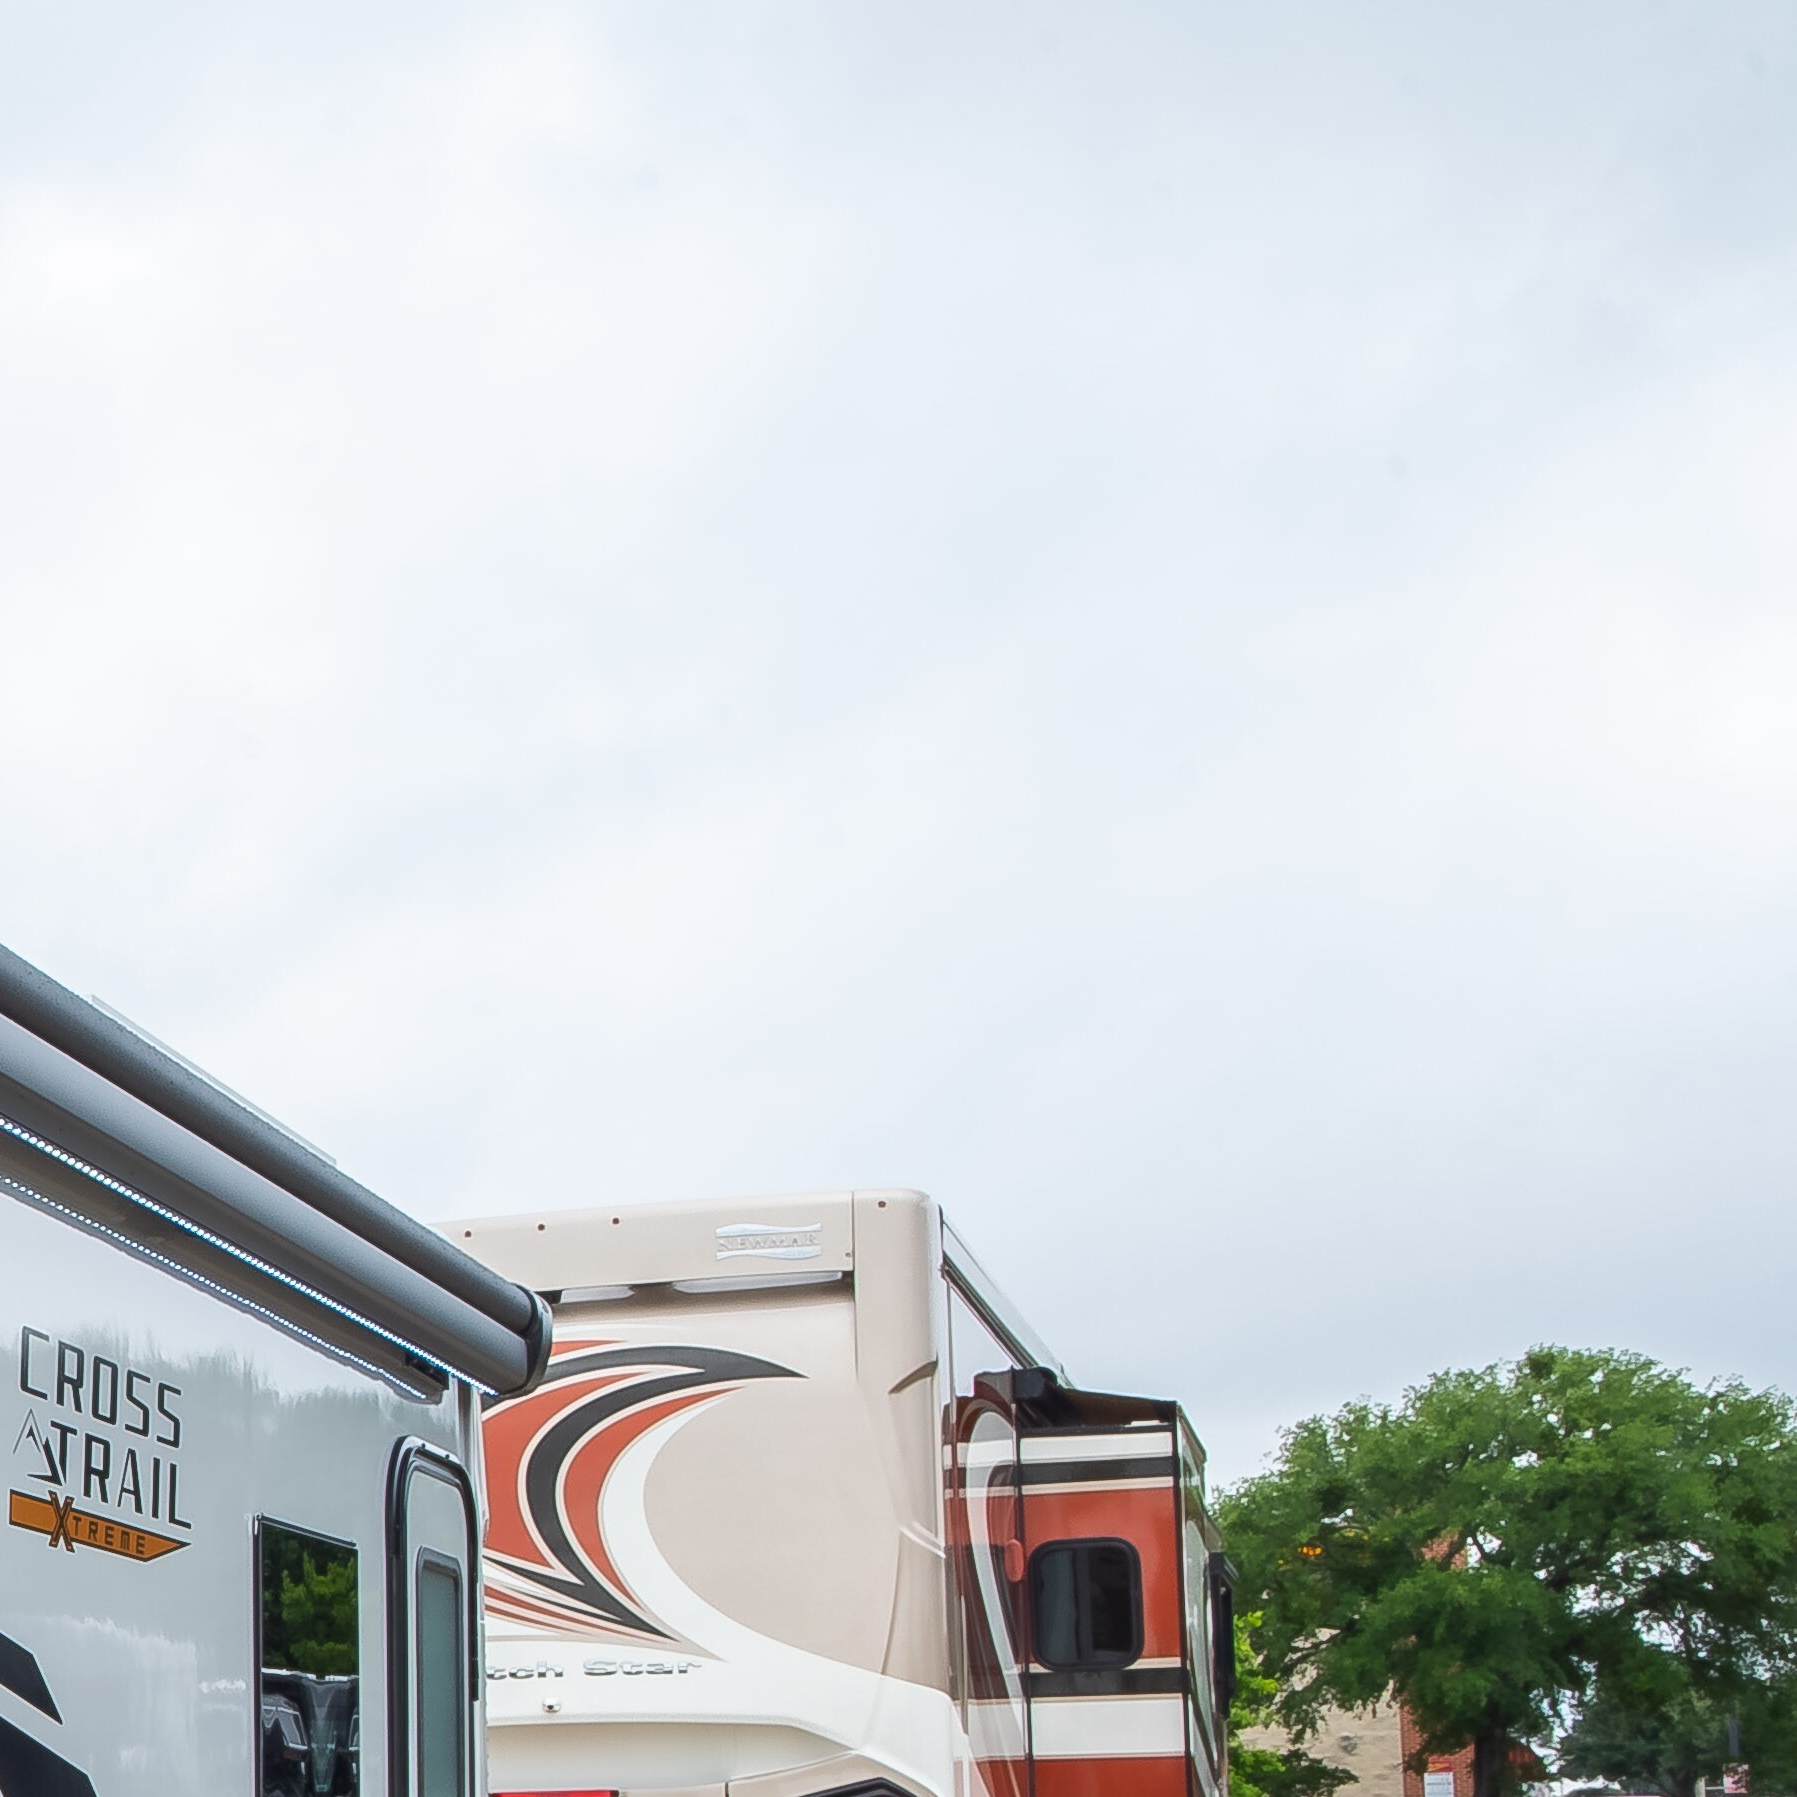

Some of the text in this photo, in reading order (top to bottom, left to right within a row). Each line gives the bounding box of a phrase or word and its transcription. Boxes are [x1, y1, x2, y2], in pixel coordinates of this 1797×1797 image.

[716, 1233, 817, 1252] NEWMAR
[20, 1325, 182, 1449] CROSS
[49, 1420, 192, 1530] TRAIL
[48, 1489, 147, 1555] XTREME
[582, 1658, 703, 1677] Star
